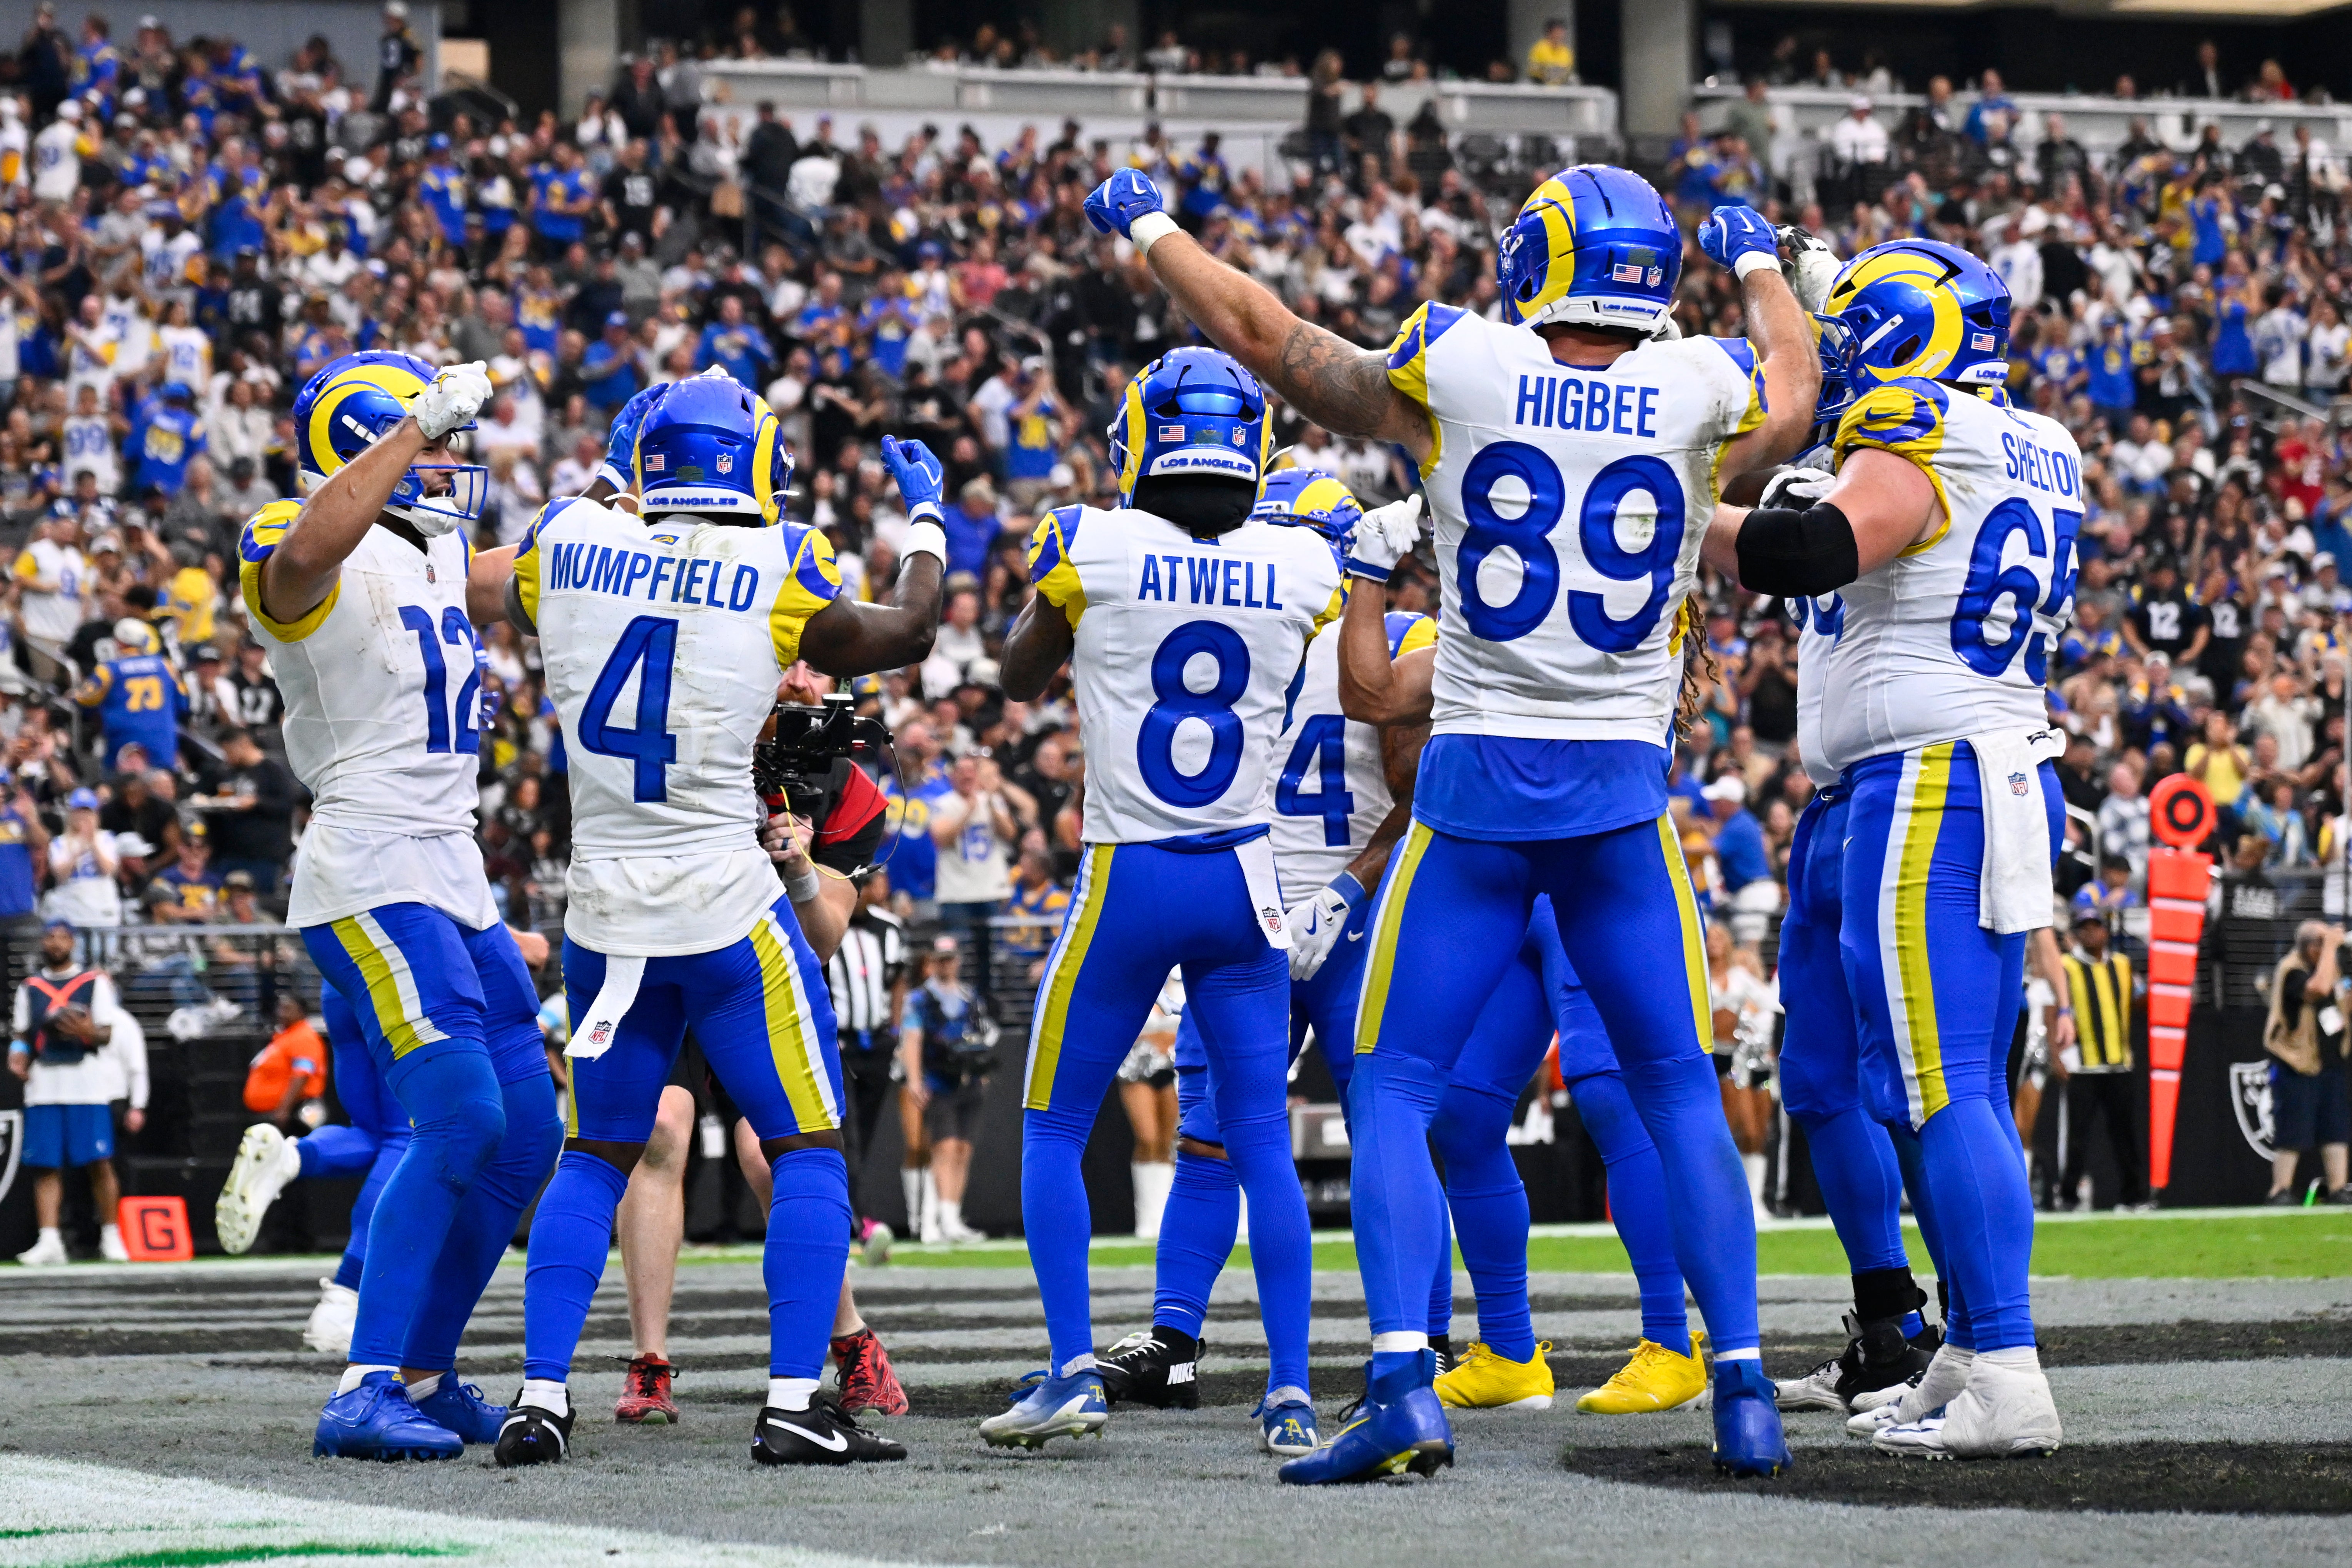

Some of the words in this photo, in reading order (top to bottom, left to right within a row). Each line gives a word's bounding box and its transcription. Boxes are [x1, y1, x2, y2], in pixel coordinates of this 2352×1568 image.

[1648, 275, 1659, 284] NFL
[1976, 370, 1997, 378] LOS
[1515, 374, 1659, 438] HIGBEE
[1234, 434, 1244, 443] NFL
[719, 462, 730, 470] NFL
[1160, 458, 1189, 468] LOS
[1191, 458, 1252, 473] ANGELES
[2002, 432, 2080, 502] SHELTON
[646, 497, 669, 505] LOS
[671, 497, 738, 506] ANGELES
[1457, 441, 1685, 653] 89
[550, 543, 759, 612] MUMPFIELD
[1138, 554, 1283, 611] ATWELL
[1950, 496, 2083, 687] 65
[2146, 601, 2181, 639] 12
[398, 605, 480, 755] 12
[577, 615, 679, 803] 4
[1136, 620, 1251, 808] 8
[1275, 714, 1354, 846] 4
[2012, 782, 2028, 794] NFL
[962, 824, 993, 862] 15
[1267, 918, 1280, 930] NFL
[591, 1031, 606, 1041] NFL
[140, 1208, 175, 1250] G
[1167, 1361, 1195, 1385] NIKE
